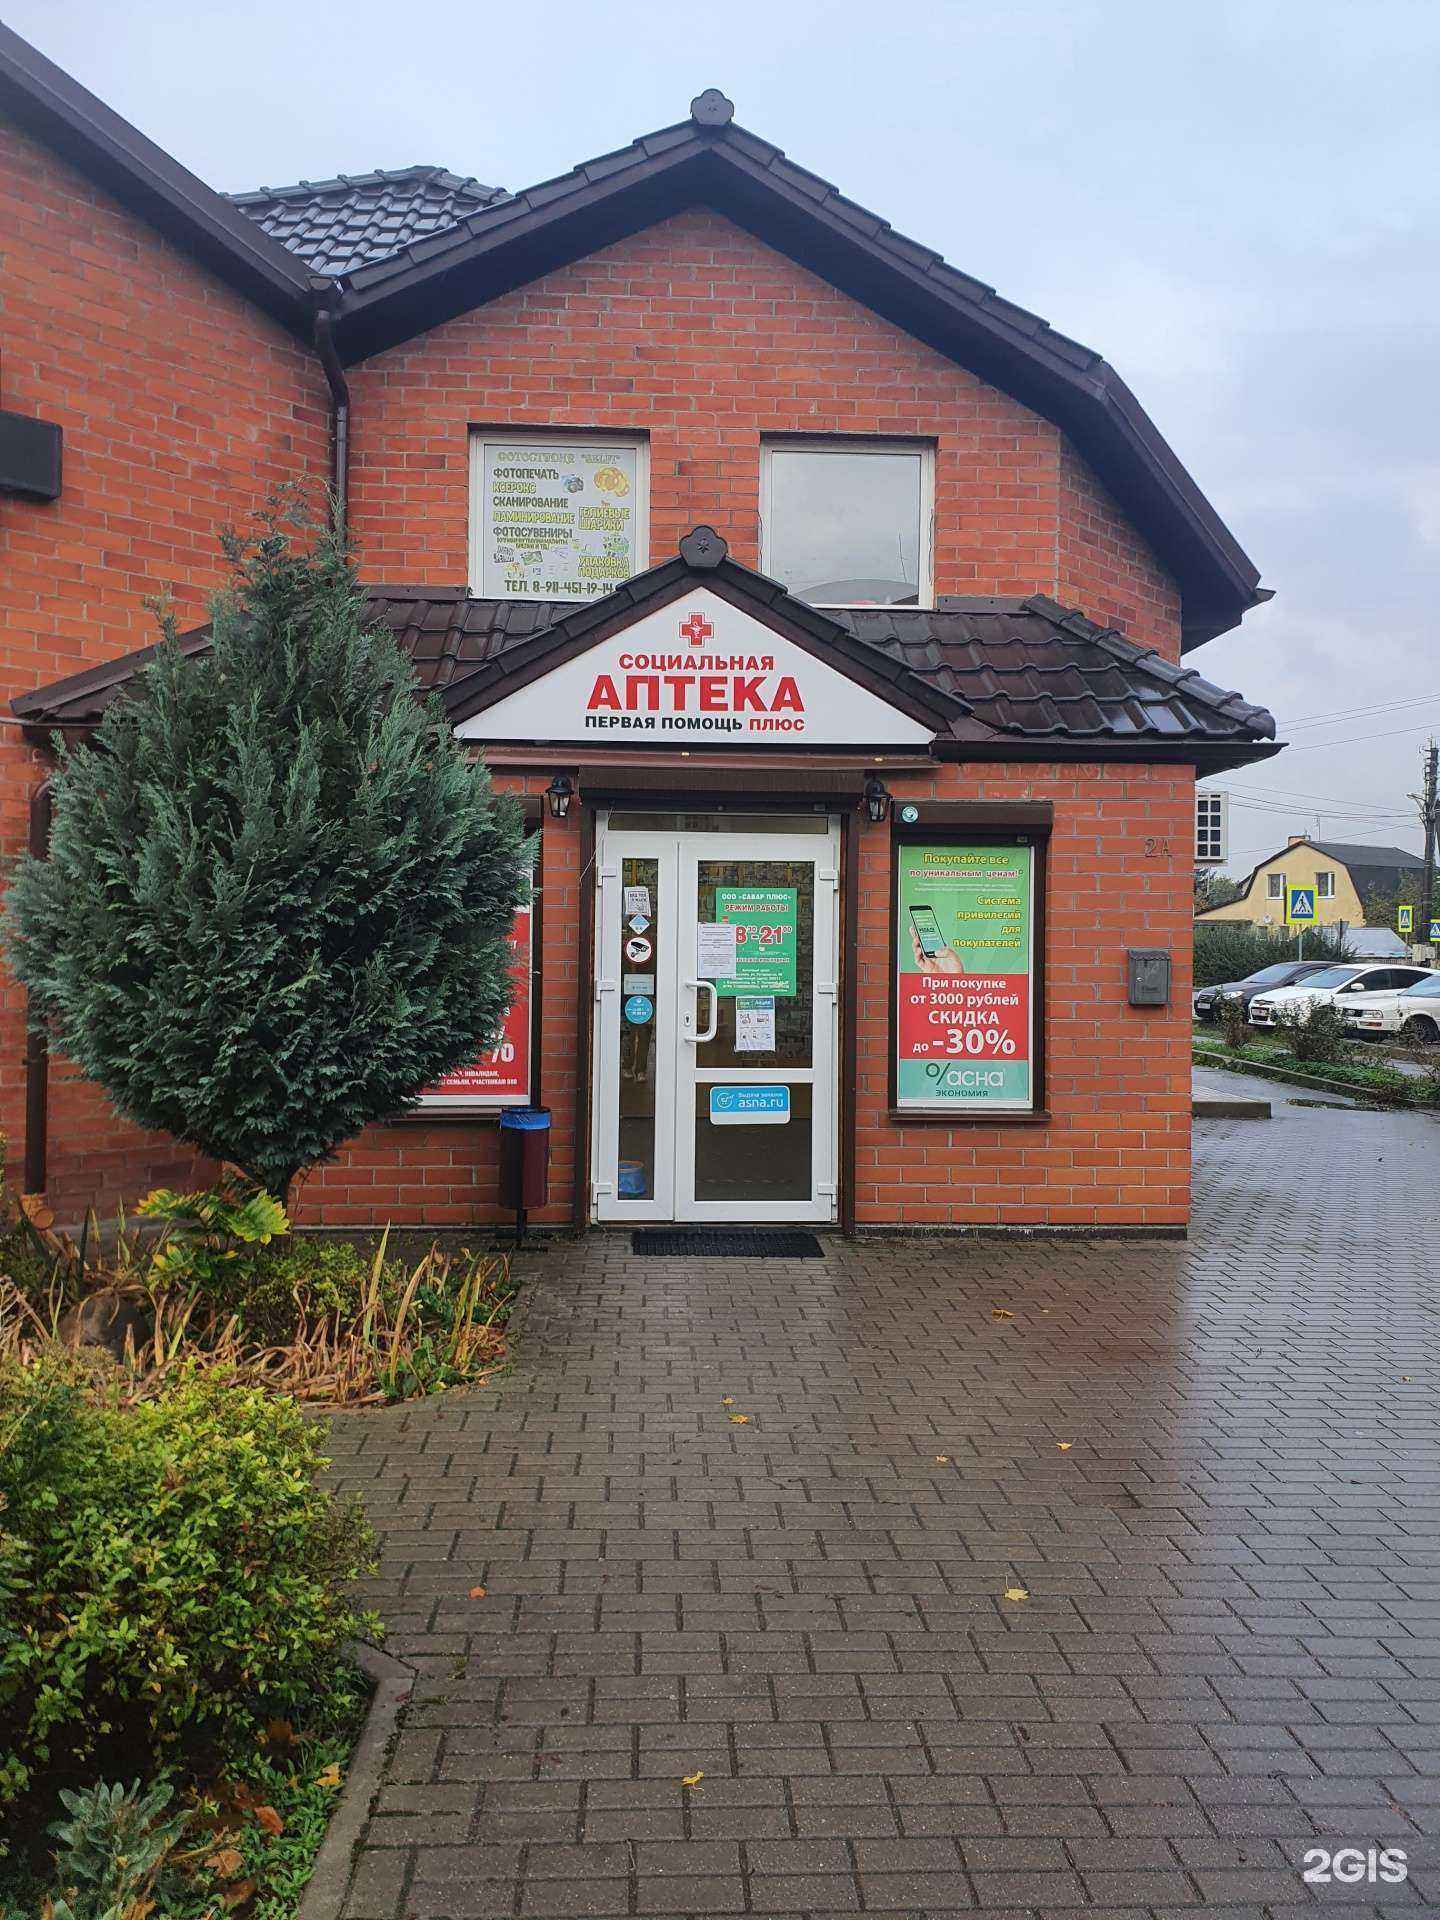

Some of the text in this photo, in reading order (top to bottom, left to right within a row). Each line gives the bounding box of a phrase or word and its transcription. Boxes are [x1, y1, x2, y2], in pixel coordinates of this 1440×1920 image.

[493, 468, 559, 479] ФОТОПЕЧАТЬ
[492, 481, 537, 494] КСЕРОКС
[493, 497, 569, 508] СКАНИРОВАНИЕ
[492, 511, 575, 524] ЛАМИНИРОВАНИЕ
[578, 507, 630, 520] ГЕЛИЕВЫЕ
[578, 519, 625, 531] ШАРИКИ
[493, 527, 573, 538] ФОТОСУВЕНИРЫ
[578, 555, 629, 568] УПАКОВКА
[578, 566, 630, 579] ПОДАРКОВ
[504, 580, 529, 592] ТЕЛ.
[619, 654, 774, 671] СОЦИАЛЬНАЯ
[587, 674, 805, 712] АПТЕКА
[585, 716, 805, 732] ПЕРВАЯ ПОМОЩЬ ПЛЮС
[923, 853, 986, 865] Покупайте
[924, 870, 982, 879] уникальным
[977, 896, 1021, 905] Система
[725, 904, 789, 912] РЕЖИМ РАБОТЫ
[956, 910, 1021, 921] привилегий
[1001, 926, 1021, 936] для
[953, 938, 1021, 949] покупателей
[922, 977, 1006, 991] При покупке
[911, 992, 1019, 1007] от 3000 рублей
[929, 1011, 999, 1027] СКИДКА
[913, 1042, 928, 1053] до
[738, 1099, 784, 1107] asna.ru
